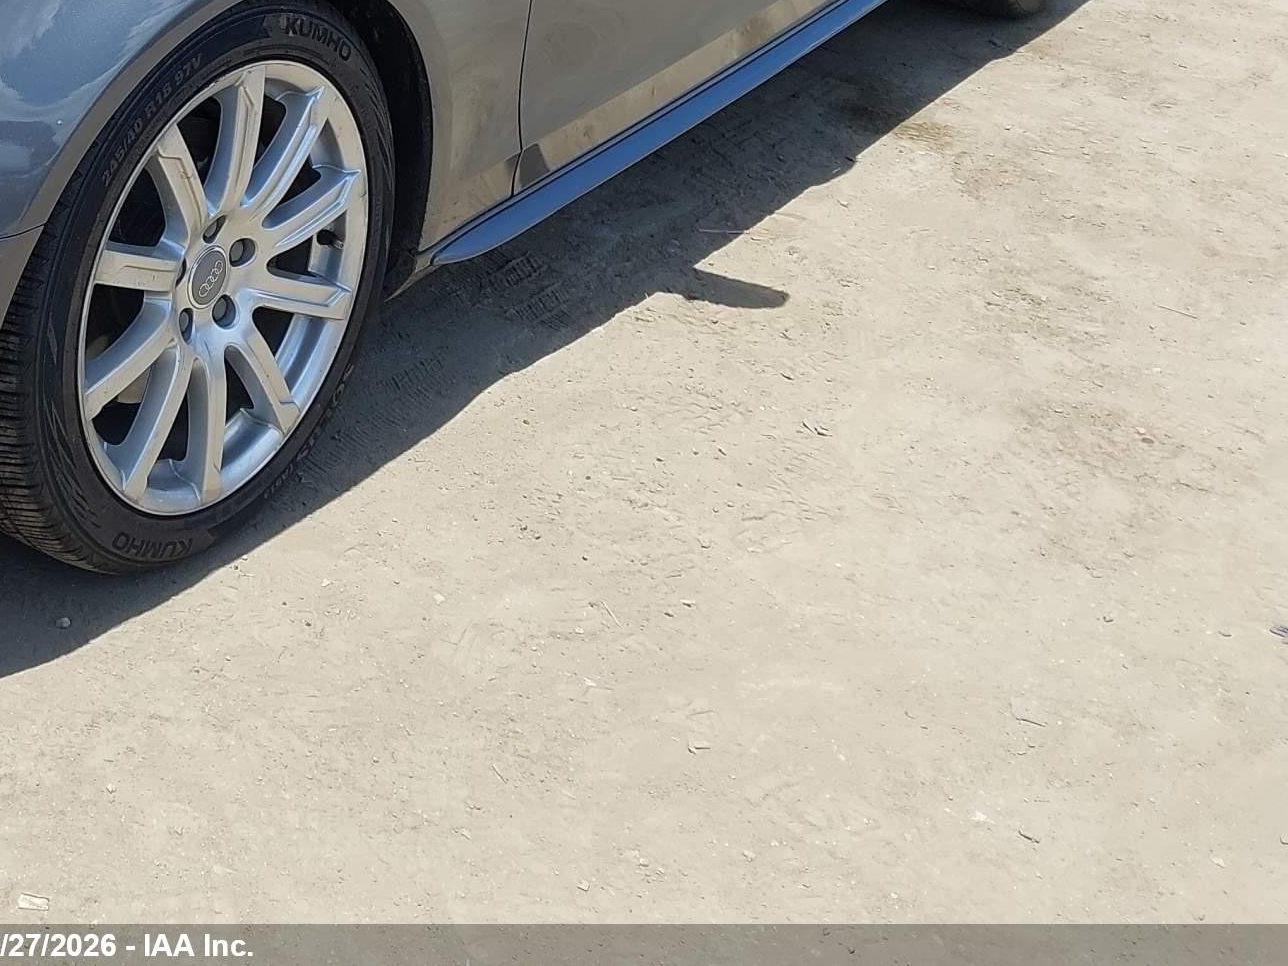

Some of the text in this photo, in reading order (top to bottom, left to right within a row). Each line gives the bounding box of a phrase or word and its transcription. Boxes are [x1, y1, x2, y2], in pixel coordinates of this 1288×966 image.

[286, 15, 352, 61] KUMHO
[174, 53, 203, 86] 97V
[112, 531, 193, 559] KUMHO
